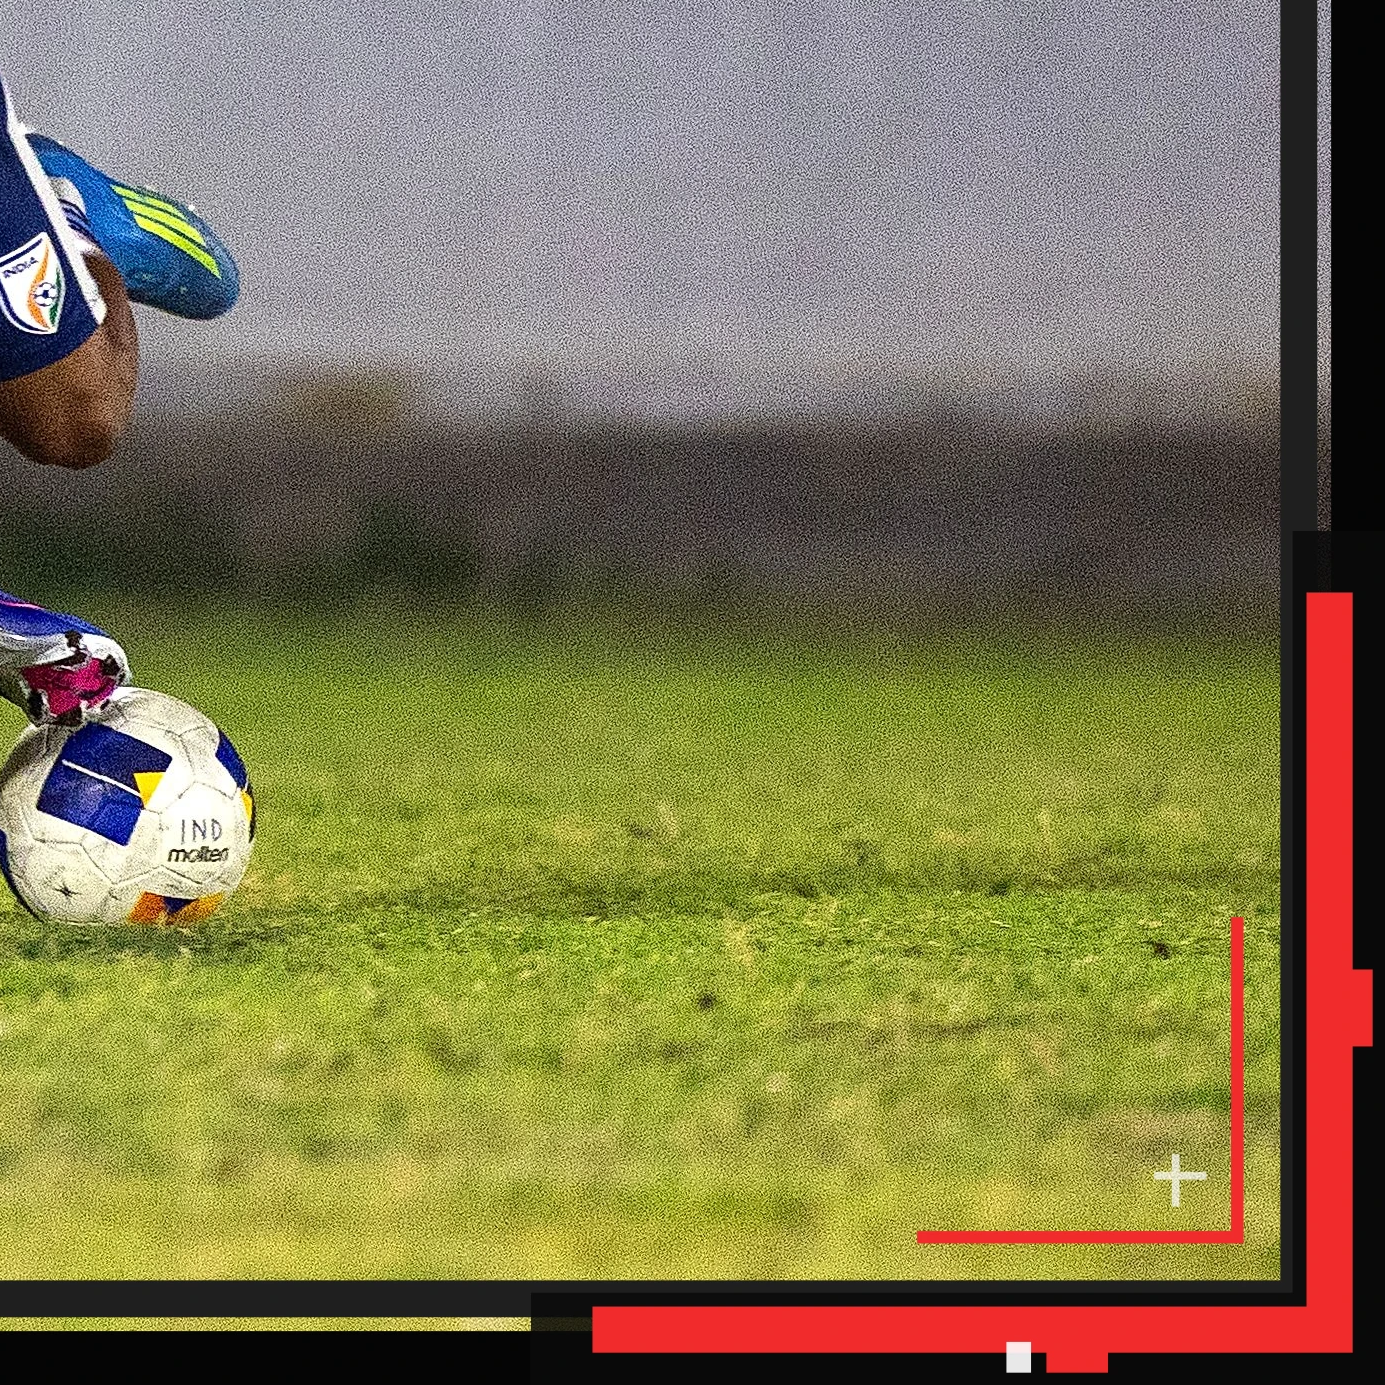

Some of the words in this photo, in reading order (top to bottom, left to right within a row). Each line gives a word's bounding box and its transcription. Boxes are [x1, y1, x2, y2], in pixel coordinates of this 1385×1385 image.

[2, 256, 39, 279] INDIA
[180, 818, 223, 845] IND
[167, 845, 230, 863] molten
